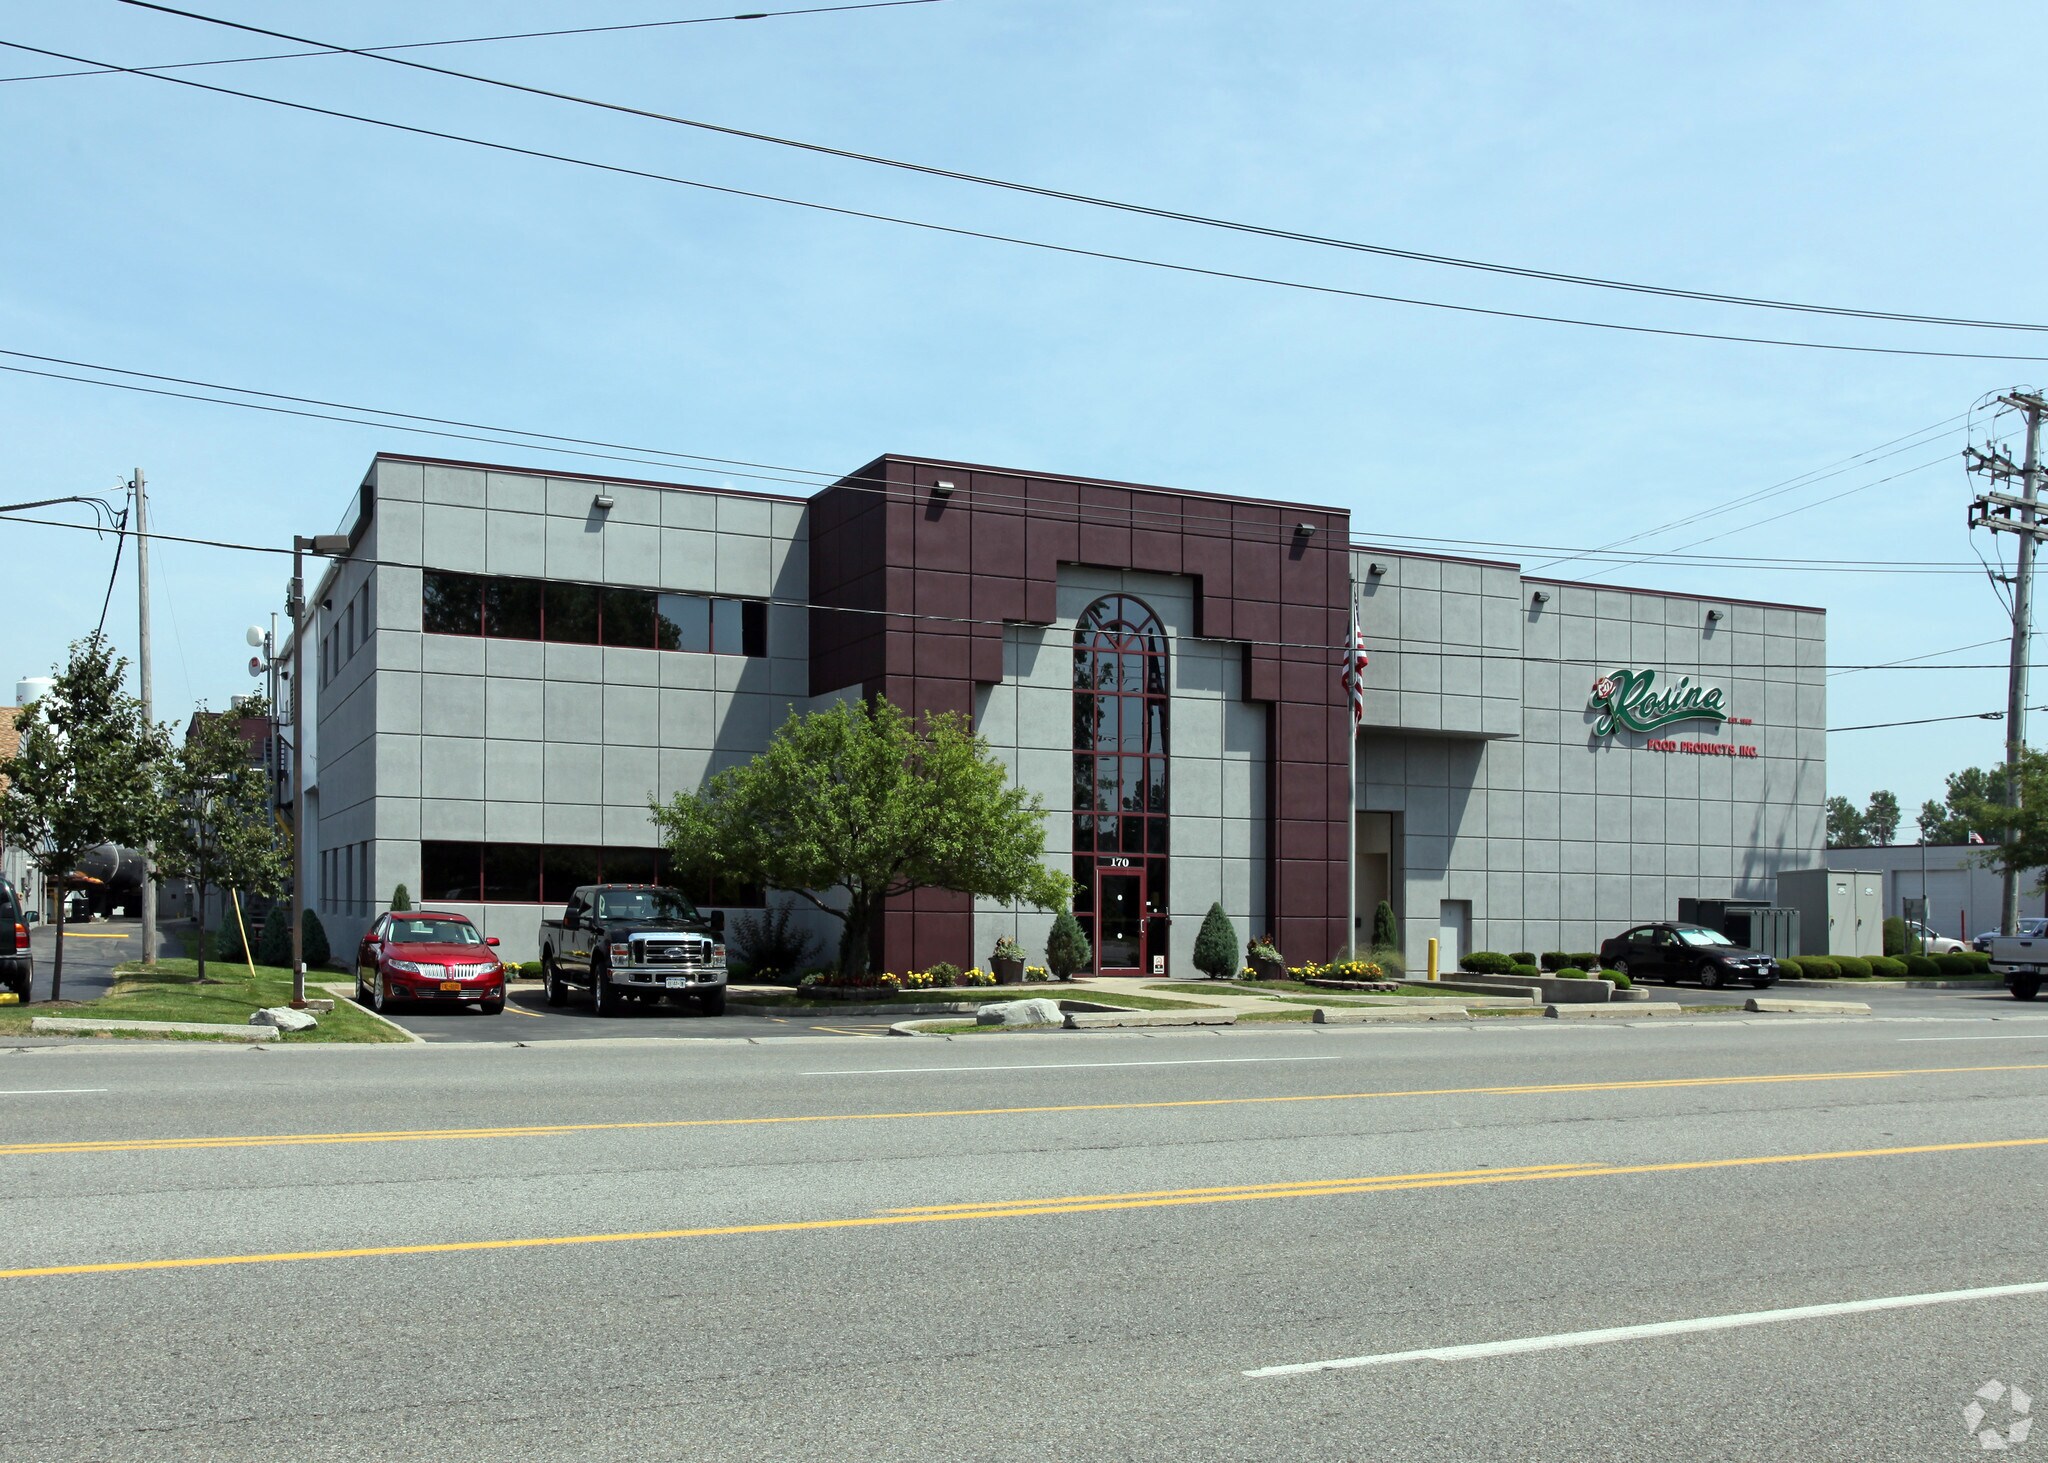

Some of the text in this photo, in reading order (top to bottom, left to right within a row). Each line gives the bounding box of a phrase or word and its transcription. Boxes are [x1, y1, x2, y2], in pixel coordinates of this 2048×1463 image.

[1589, 669, 1727, 737] Rosina
[1647, 739, 1677, 752] FOOD
[1739, 744, 1759, 757] INC.
[1110, 857, 1130, 867] 170
